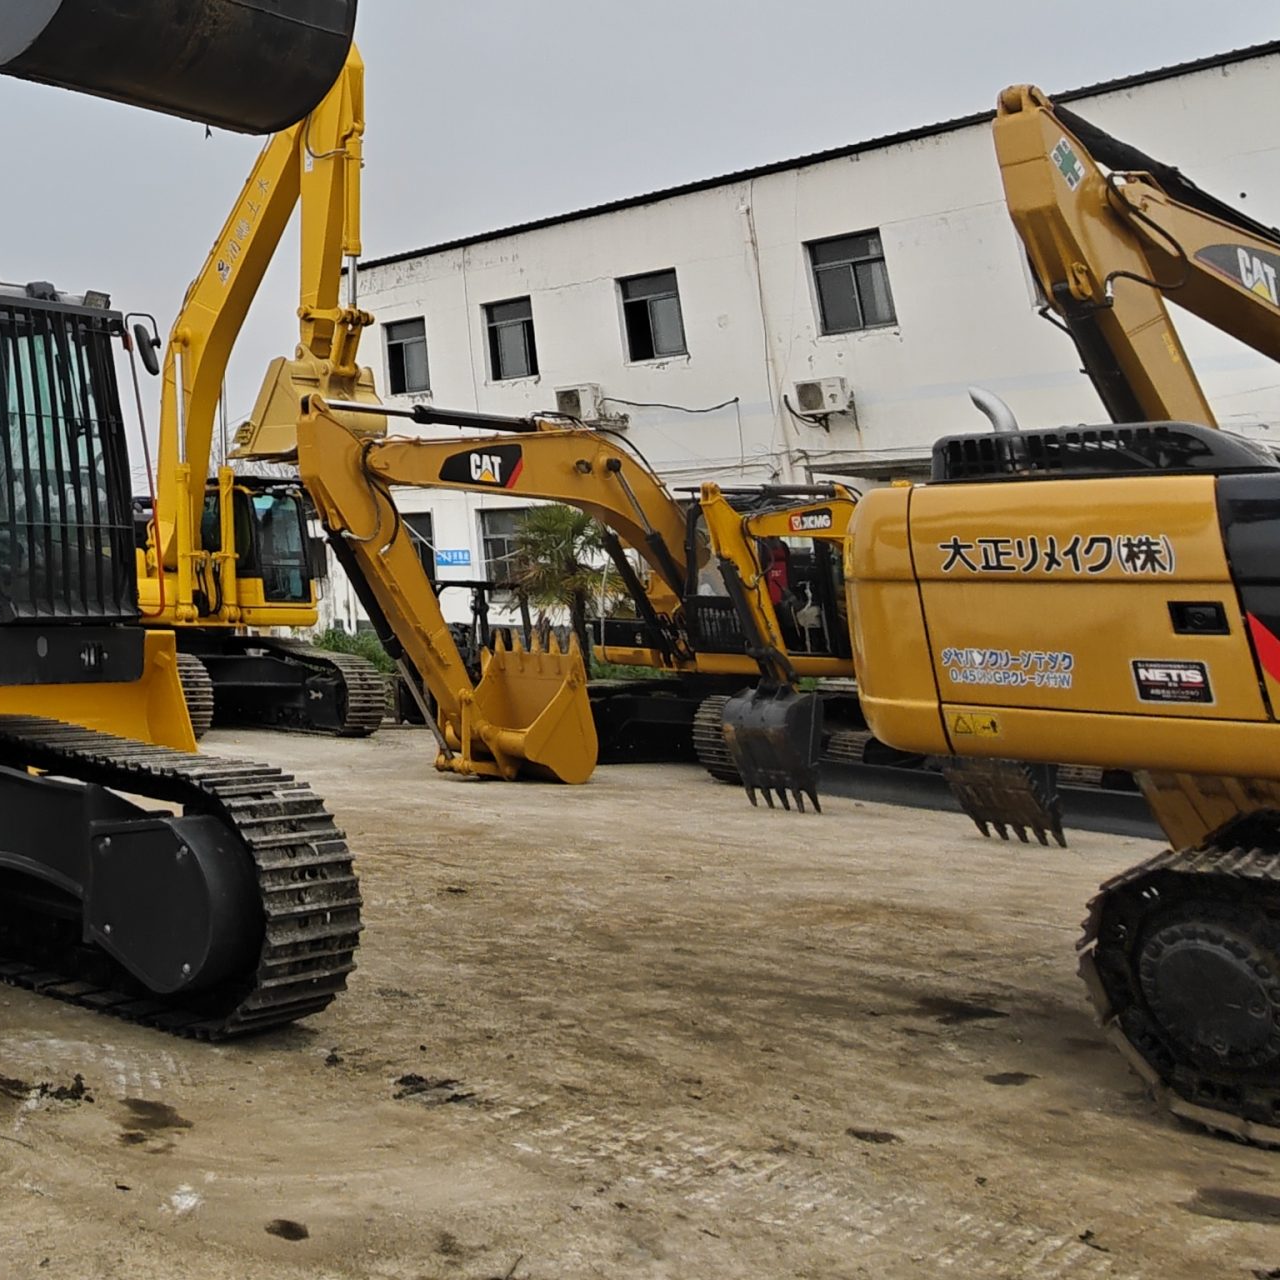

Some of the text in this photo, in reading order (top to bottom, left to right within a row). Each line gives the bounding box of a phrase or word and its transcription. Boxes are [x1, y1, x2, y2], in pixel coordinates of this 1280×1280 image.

[1237, 247, 1279, 306] CAT
[470, 453, 501, 482] CAT
[1138, 669, 1203, 682] NETIS
